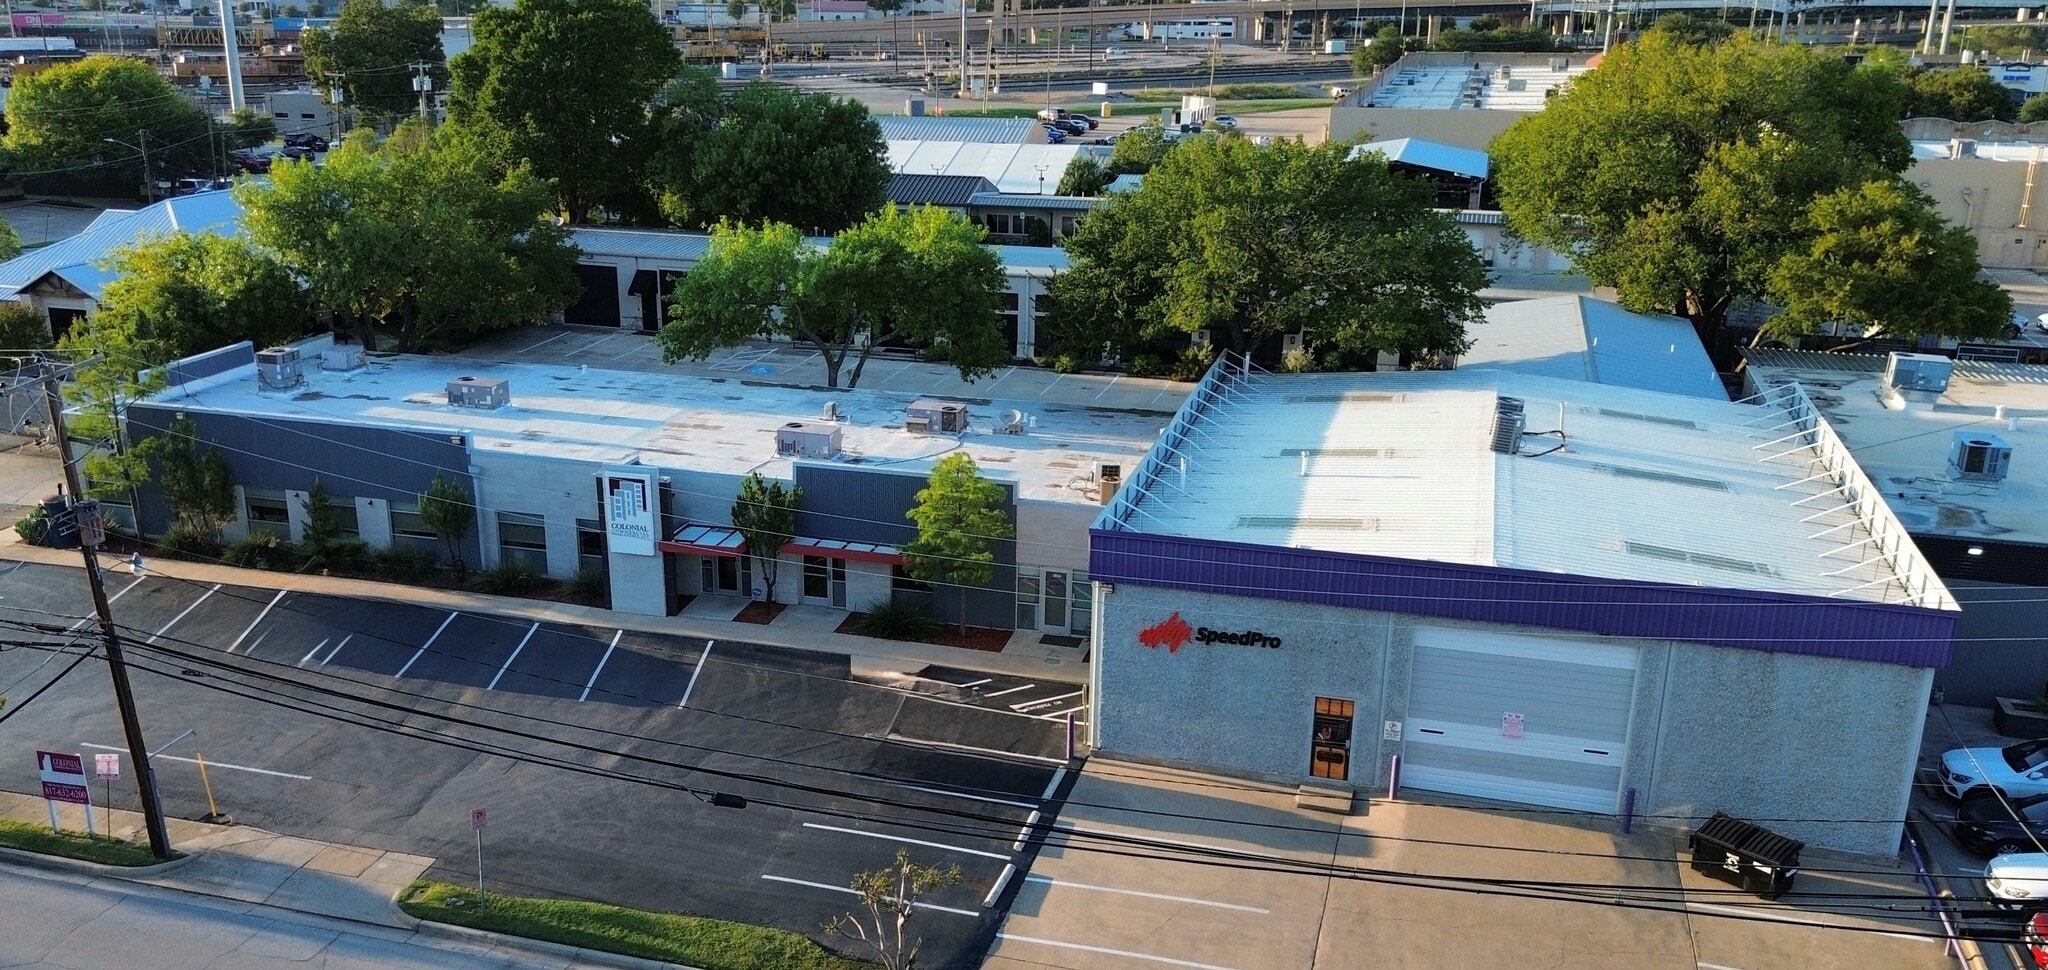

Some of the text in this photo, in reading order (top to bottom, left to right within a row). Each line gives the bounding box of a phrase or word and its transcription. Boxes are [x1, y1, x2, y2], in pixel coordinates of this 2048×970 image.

[611, 523, 647, 532] COLONIAL
[1195, 626, 1282, 649] SpeedPro
[52, 758, 81, 769] COLONIAL
